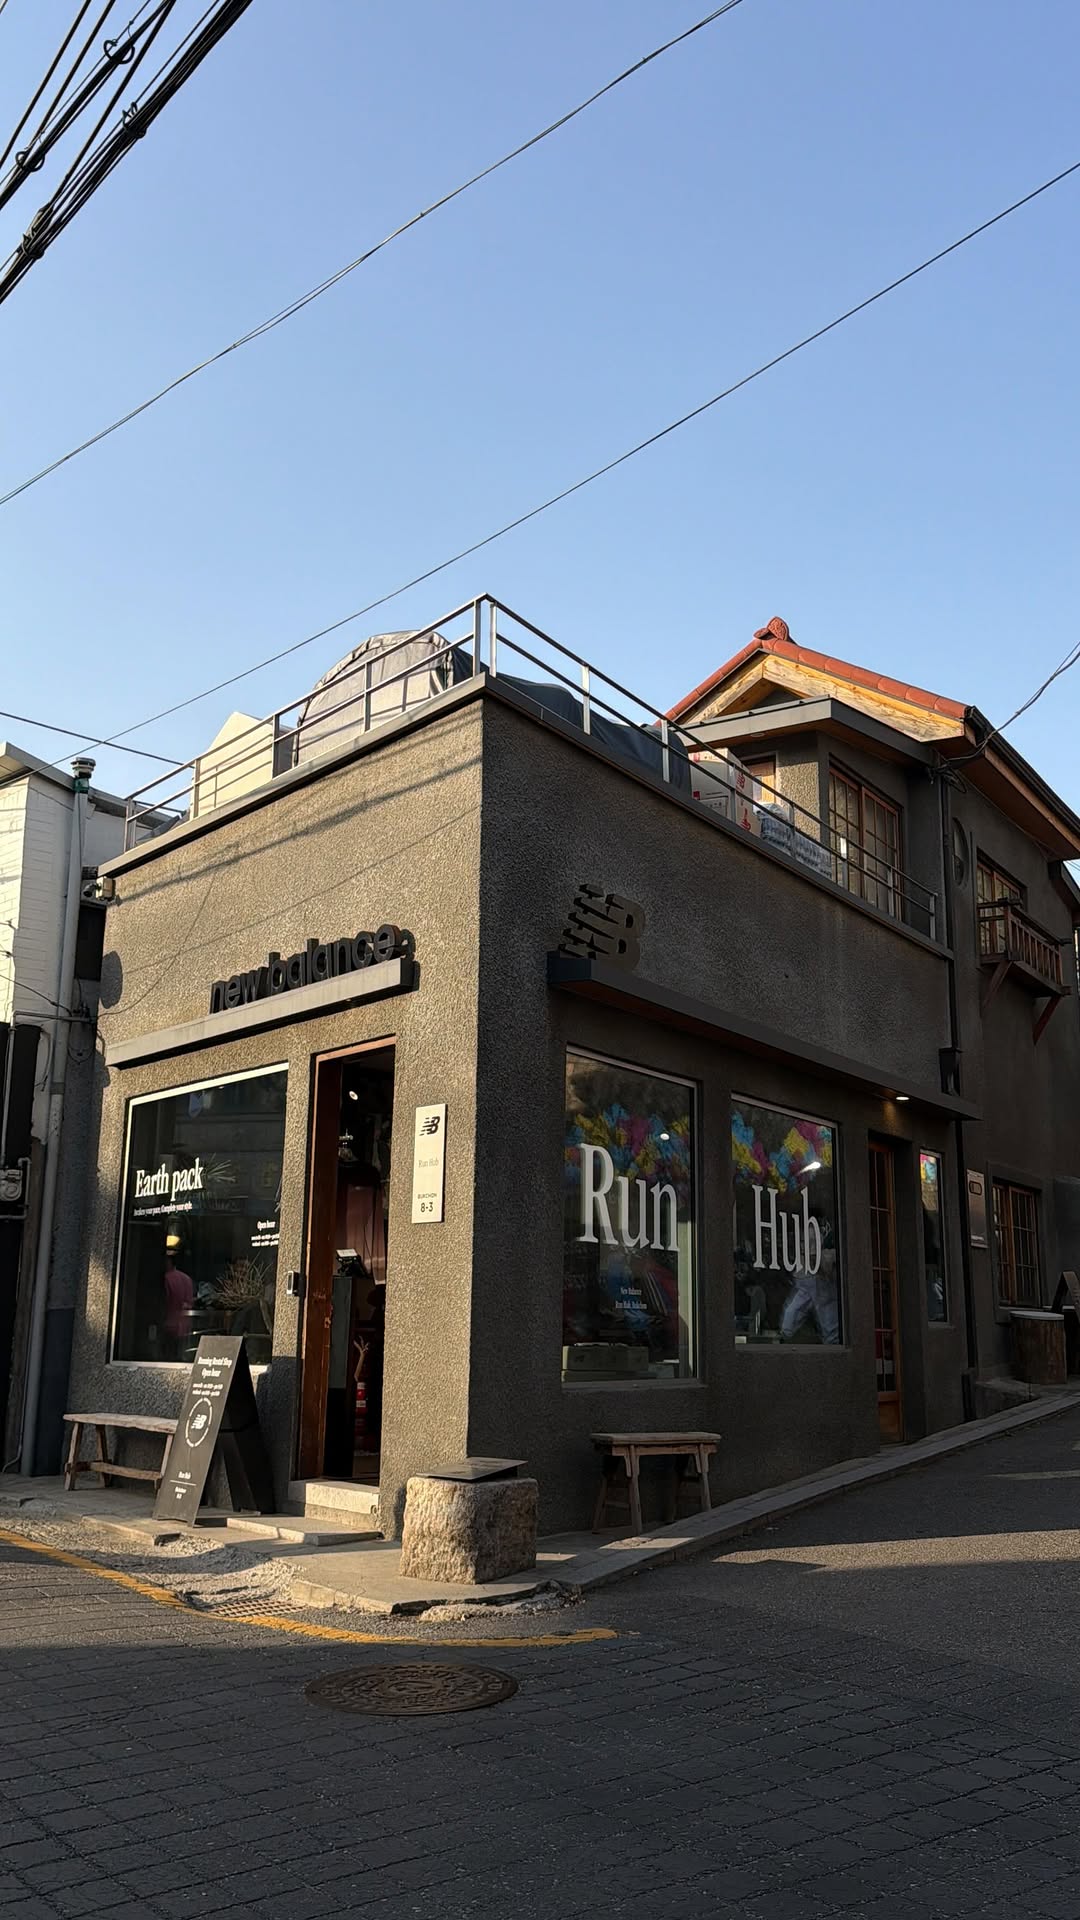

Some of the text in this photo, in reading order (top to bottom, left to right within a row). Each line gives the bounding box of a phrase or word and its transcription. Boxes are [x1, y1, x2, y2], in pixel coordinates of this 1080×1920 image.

[209, 923, 401, 1015] new balance
[418, 1156, 440, 1169] Run Hub
[134, 1157, 204, 1202] Earth pack
[577, 1143, 680, 1252] Run
[420, 1201, 434, 1213] 8-3
[257, 1220, 267, 1231] Open
[752, 1184, 822, 1275] Hub
[198, 1357, 213, 1367] Running
[201, 1368, 212, 1379] Open
